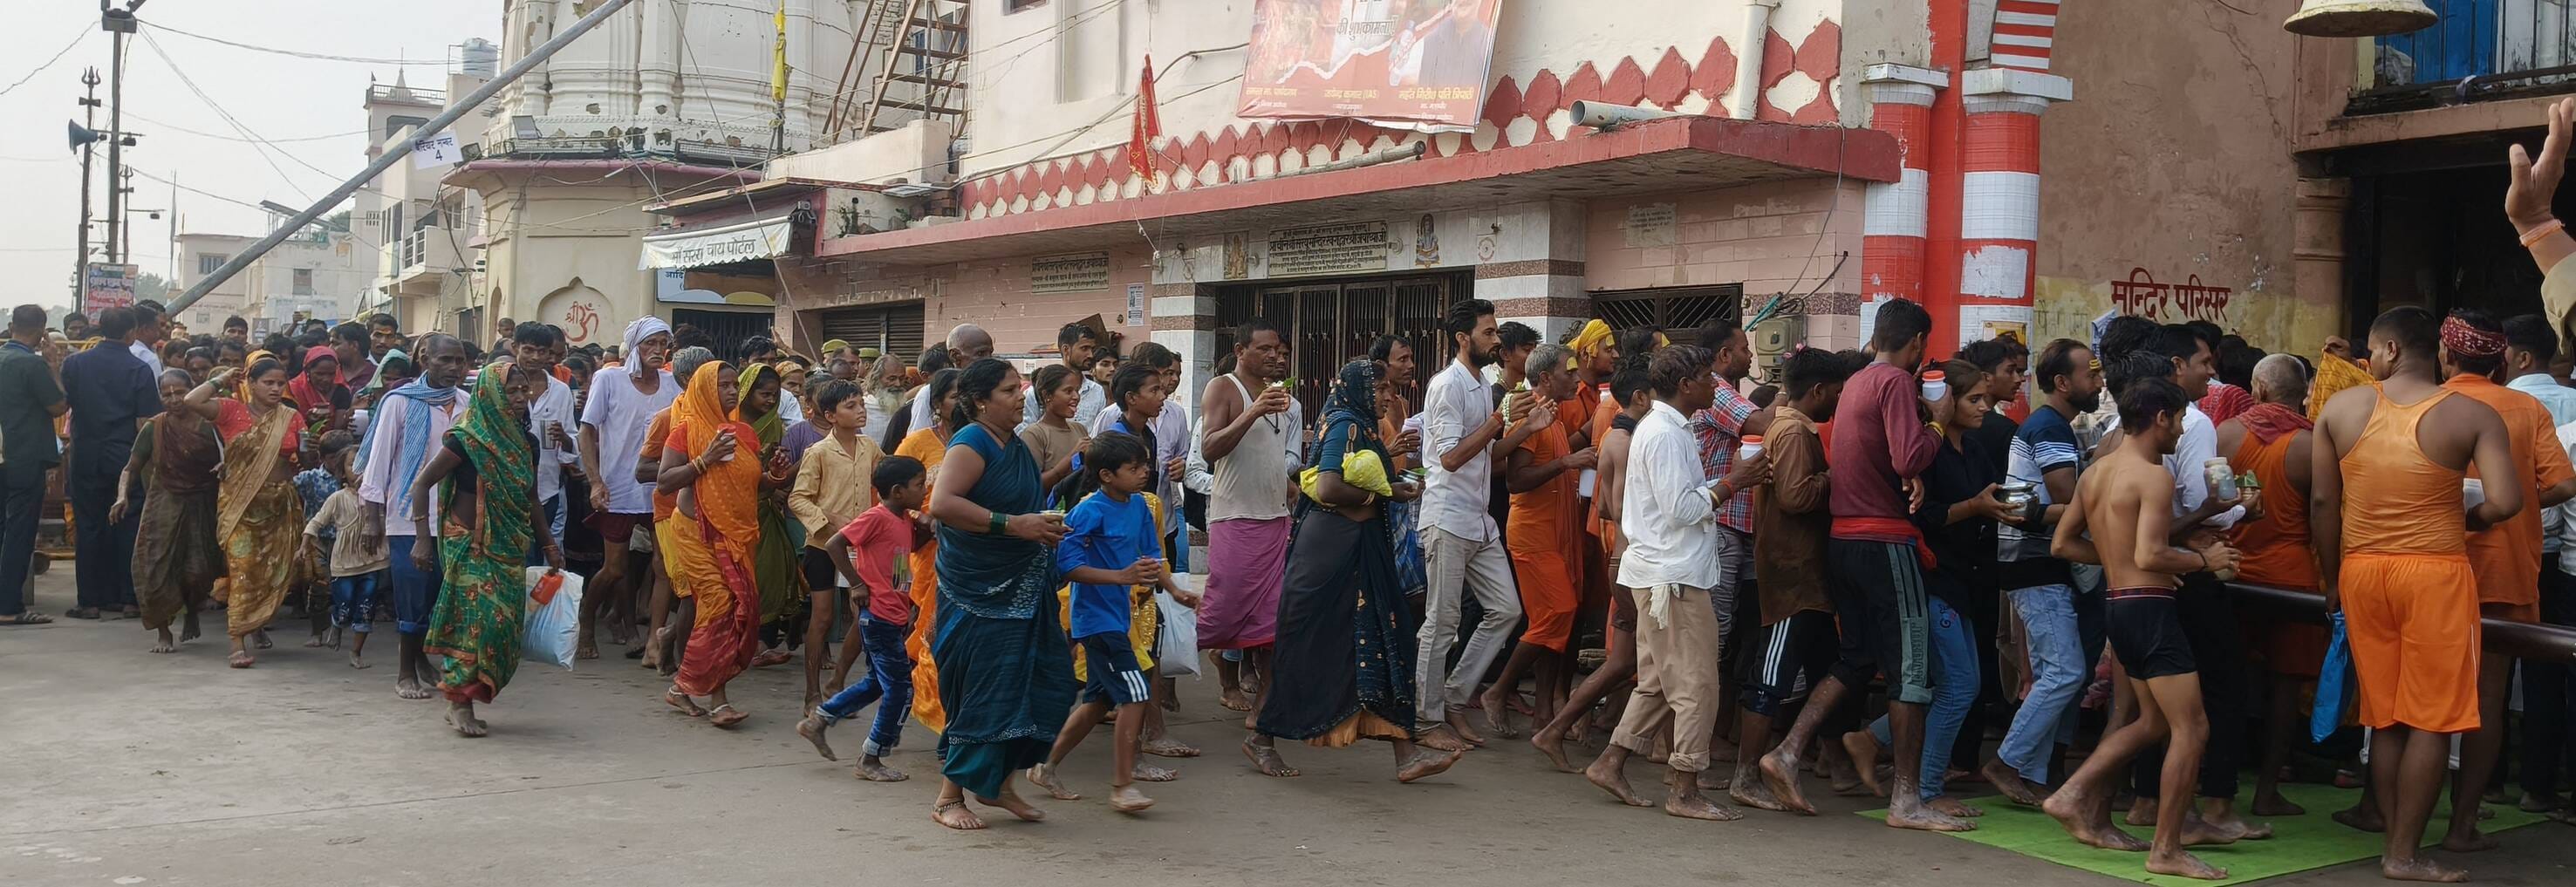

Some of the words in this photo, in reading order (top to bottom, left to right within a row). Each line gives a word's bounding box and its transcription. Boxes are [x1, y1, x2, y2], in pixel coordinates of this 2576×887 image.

[1336, 17, 1349, 35] की
[435, 149, 443, 161] 4
[707, 242, 727, 258] चाय
[727, 235, 756, 256] पोर्टल
[2111, 267, 2170, 322] मन्दिर
[2173, 273, 2231, 323] परिसर
